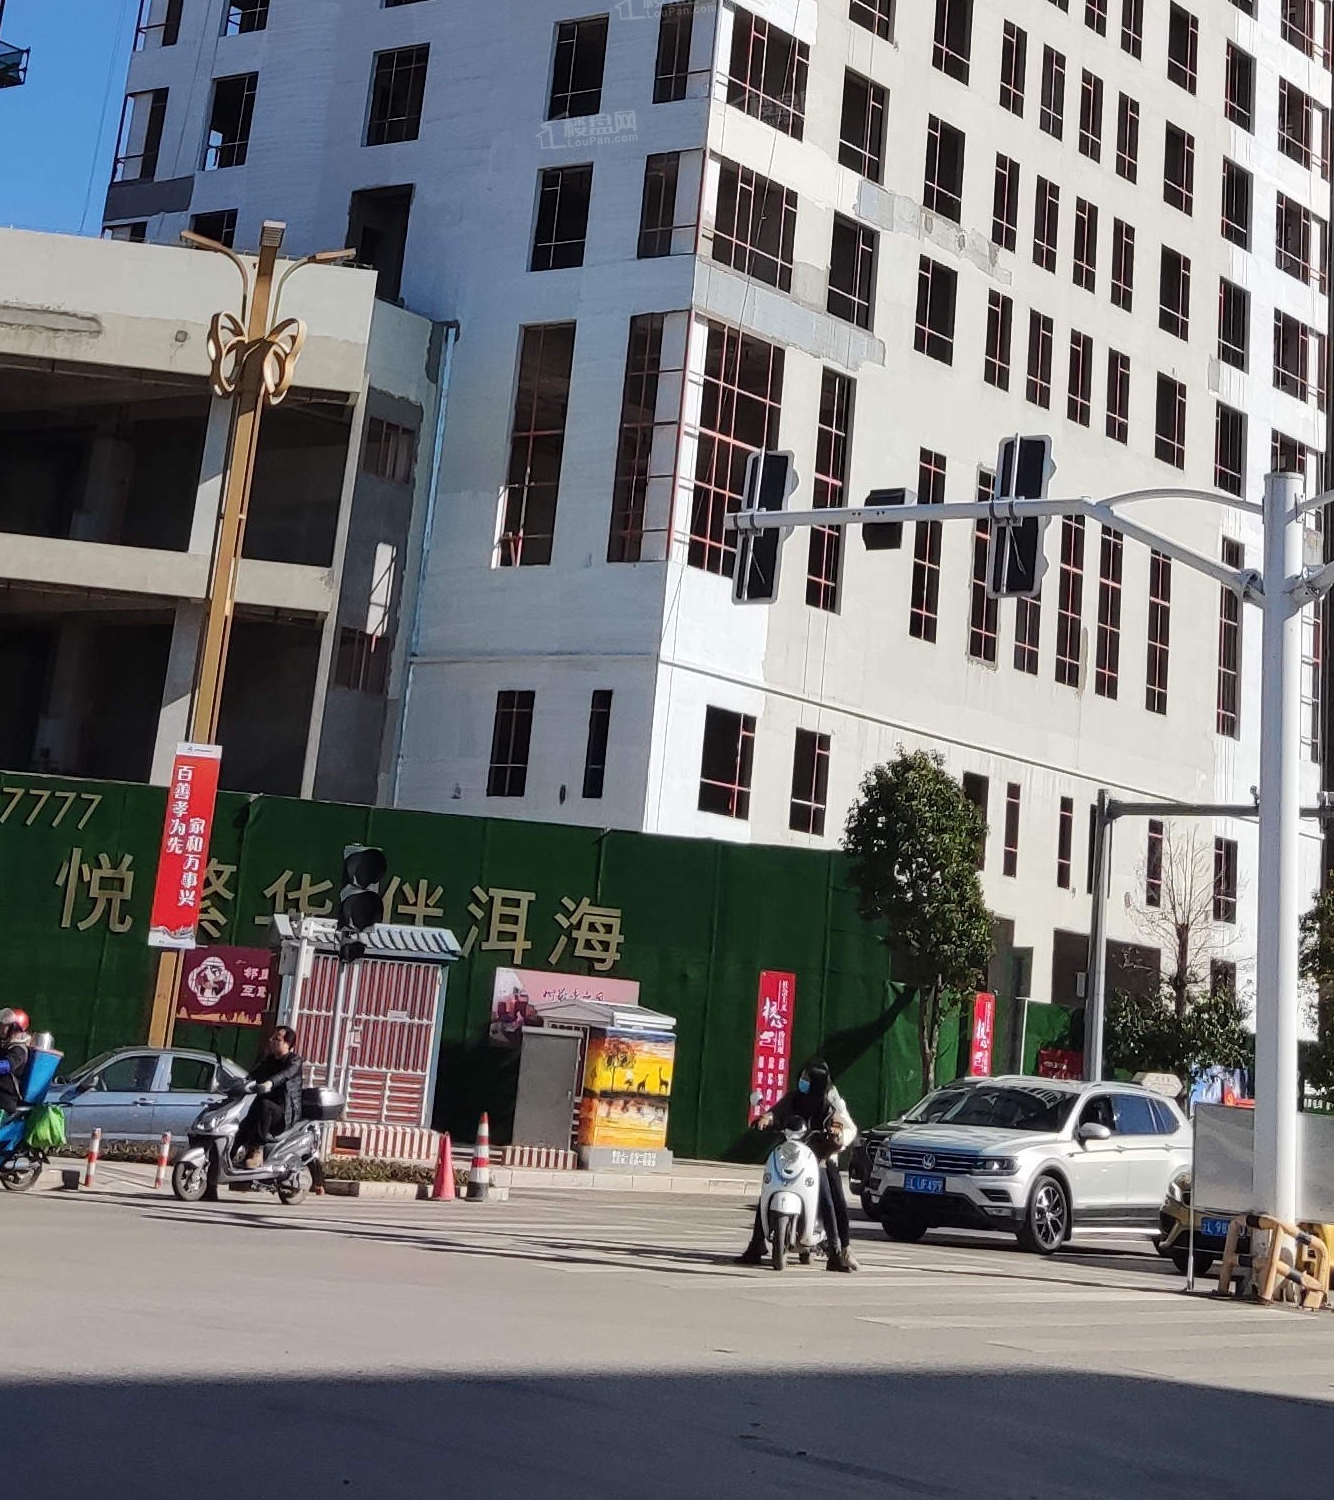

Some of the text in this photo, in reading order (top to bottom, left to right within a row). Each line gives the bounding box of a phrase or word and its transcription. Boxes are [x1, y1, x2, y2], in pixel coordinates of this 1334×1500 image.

[167, 766, 196, 855] 百善孝为先
[178, 817, 206, 907] 家和万事兴
